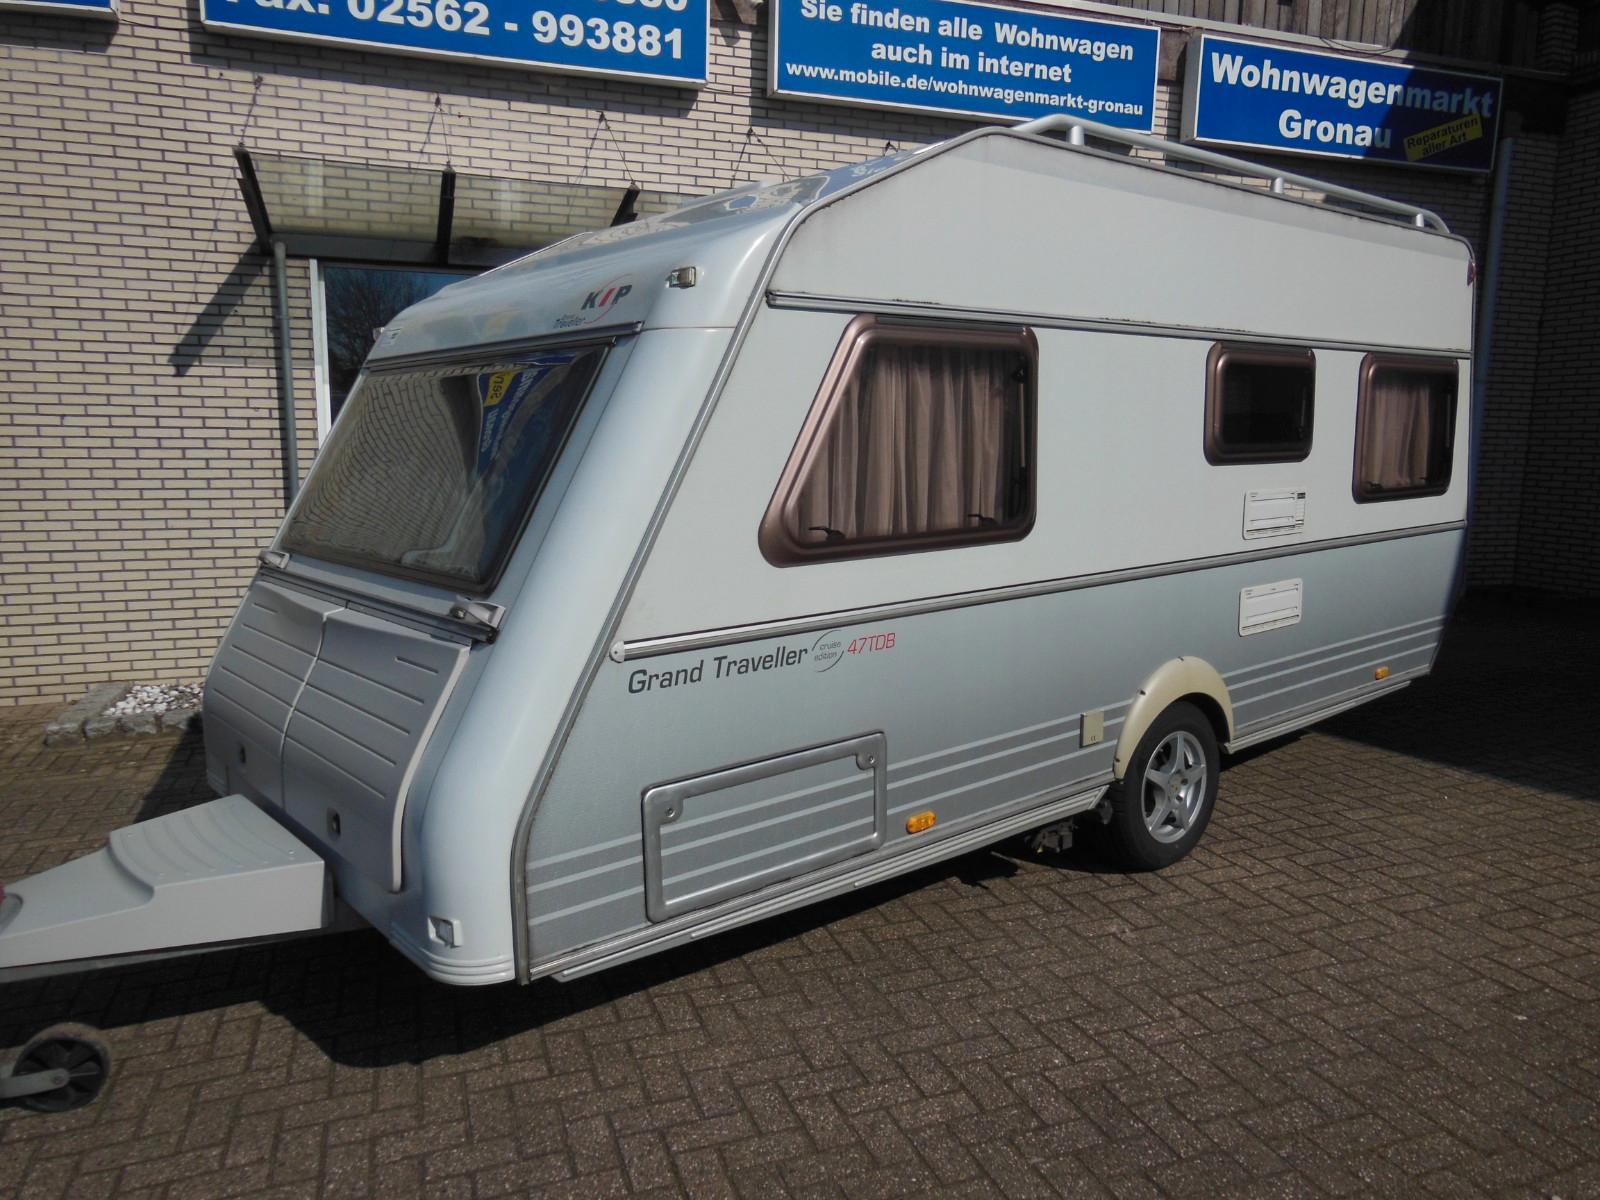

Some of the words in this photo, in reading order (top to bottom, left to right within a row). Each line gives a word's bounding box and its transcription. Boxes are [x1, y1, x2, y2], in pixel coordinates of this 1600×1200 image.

[348, 0, 490, 37] 02562
[504, 22, 519, 32] -
[532, 10, 682, 60] 993881
[801, 0, 843, 22] Sie
[850, 3, 930, 34] finden
[938, 17, 983, 41] alle
[994, 21, 1134, 62] Wohnwagen
[871, 42, 933, 66] auch
[940, 46, 970, 71] im
[977, 51, 1072, 83] internet
[785, 62, 1143, 115] www.mobile.de/wohnwagenmarkt-gronau
[1211, 52, 1493, 118] Wohnwagenmarkt
[1278, 109, 1391, 149] Gronau
[1407, 118, 1478, 149] Reparaturen
[1449, 131, 1466, 146] Art
[581, 285, 633, 310] KIP
[847, 632, 896, 655] 47TDB
[628, 659, 704, 694] Grand
[713, 646, 808, 679] Traveller
